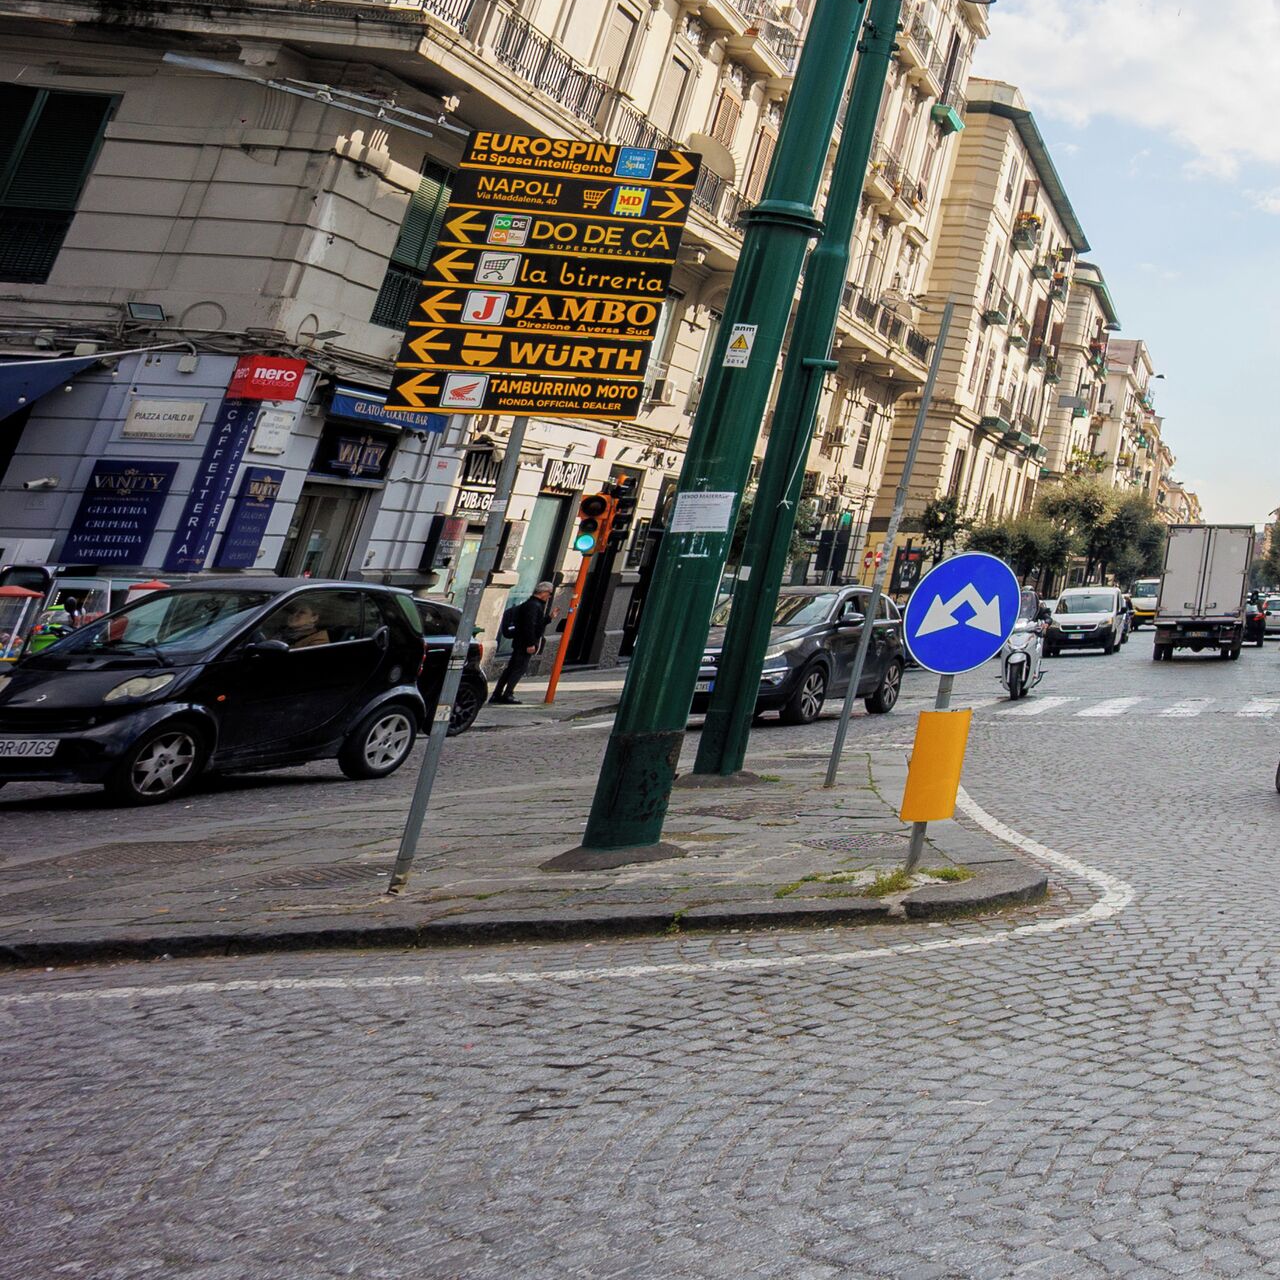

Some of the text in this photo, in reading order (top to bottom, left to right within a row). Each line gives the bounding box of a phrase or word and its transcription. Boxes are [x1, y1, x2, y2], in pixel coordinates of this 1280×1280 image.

[473, 132, 616, 163] EUROSPIN
[470, 151, 613, 175] La Spesa intelligente
[478, 176, 562, 198] NAPOLI
[476, 191, 491, 200] Via
[493, 193, 544, 205] Maddalena,
[619, 195, 642, 206] MD
[512, 220, 526, 229] DE
[492, 231, 507, 239] CA
[532, 221, 670, 250] DO DE CÀ
[549, 243, 647, 257] SUPERMERCATI
[520, 258, 664, 292] la birreria
[472, 295, 501, 320] J
[505, 295, 657, 326] JAMBO
[516, 320, 650, 336] Direzione Aversa Sud
[734, 325, 755, 333] anm
[510, 341, 642, 370] WÜRTH
[253, 367, 298, 382] nero
[251, 378, 295, 388] espresso
[490, 379, 638, 399] TAMBURRINO MOTO
[499, 398, 621, 411] HONDA OFFICIAL DEALER
[134, 412, 161, 420] PIAZZA
[162, 413, 188, 421] CARLO
[354, 402, 380, 416] GELATO
[386, 410, 414, 424] COCKTAIL
[415, 414, 428, 426] BAR
[93, 475, 165, 490] VANITY
[177, 409, 239, 555] CAFFETTERIA
[197, 411, 254, 555] CAFFETTERIA
[87, 505, 148, 515] GELATERIA
[85, 520, 139, 529] CREPERIA
[72, 534, 143, 543] YOGURTERIA
[75, 549, 129, 558] APERITIVI
